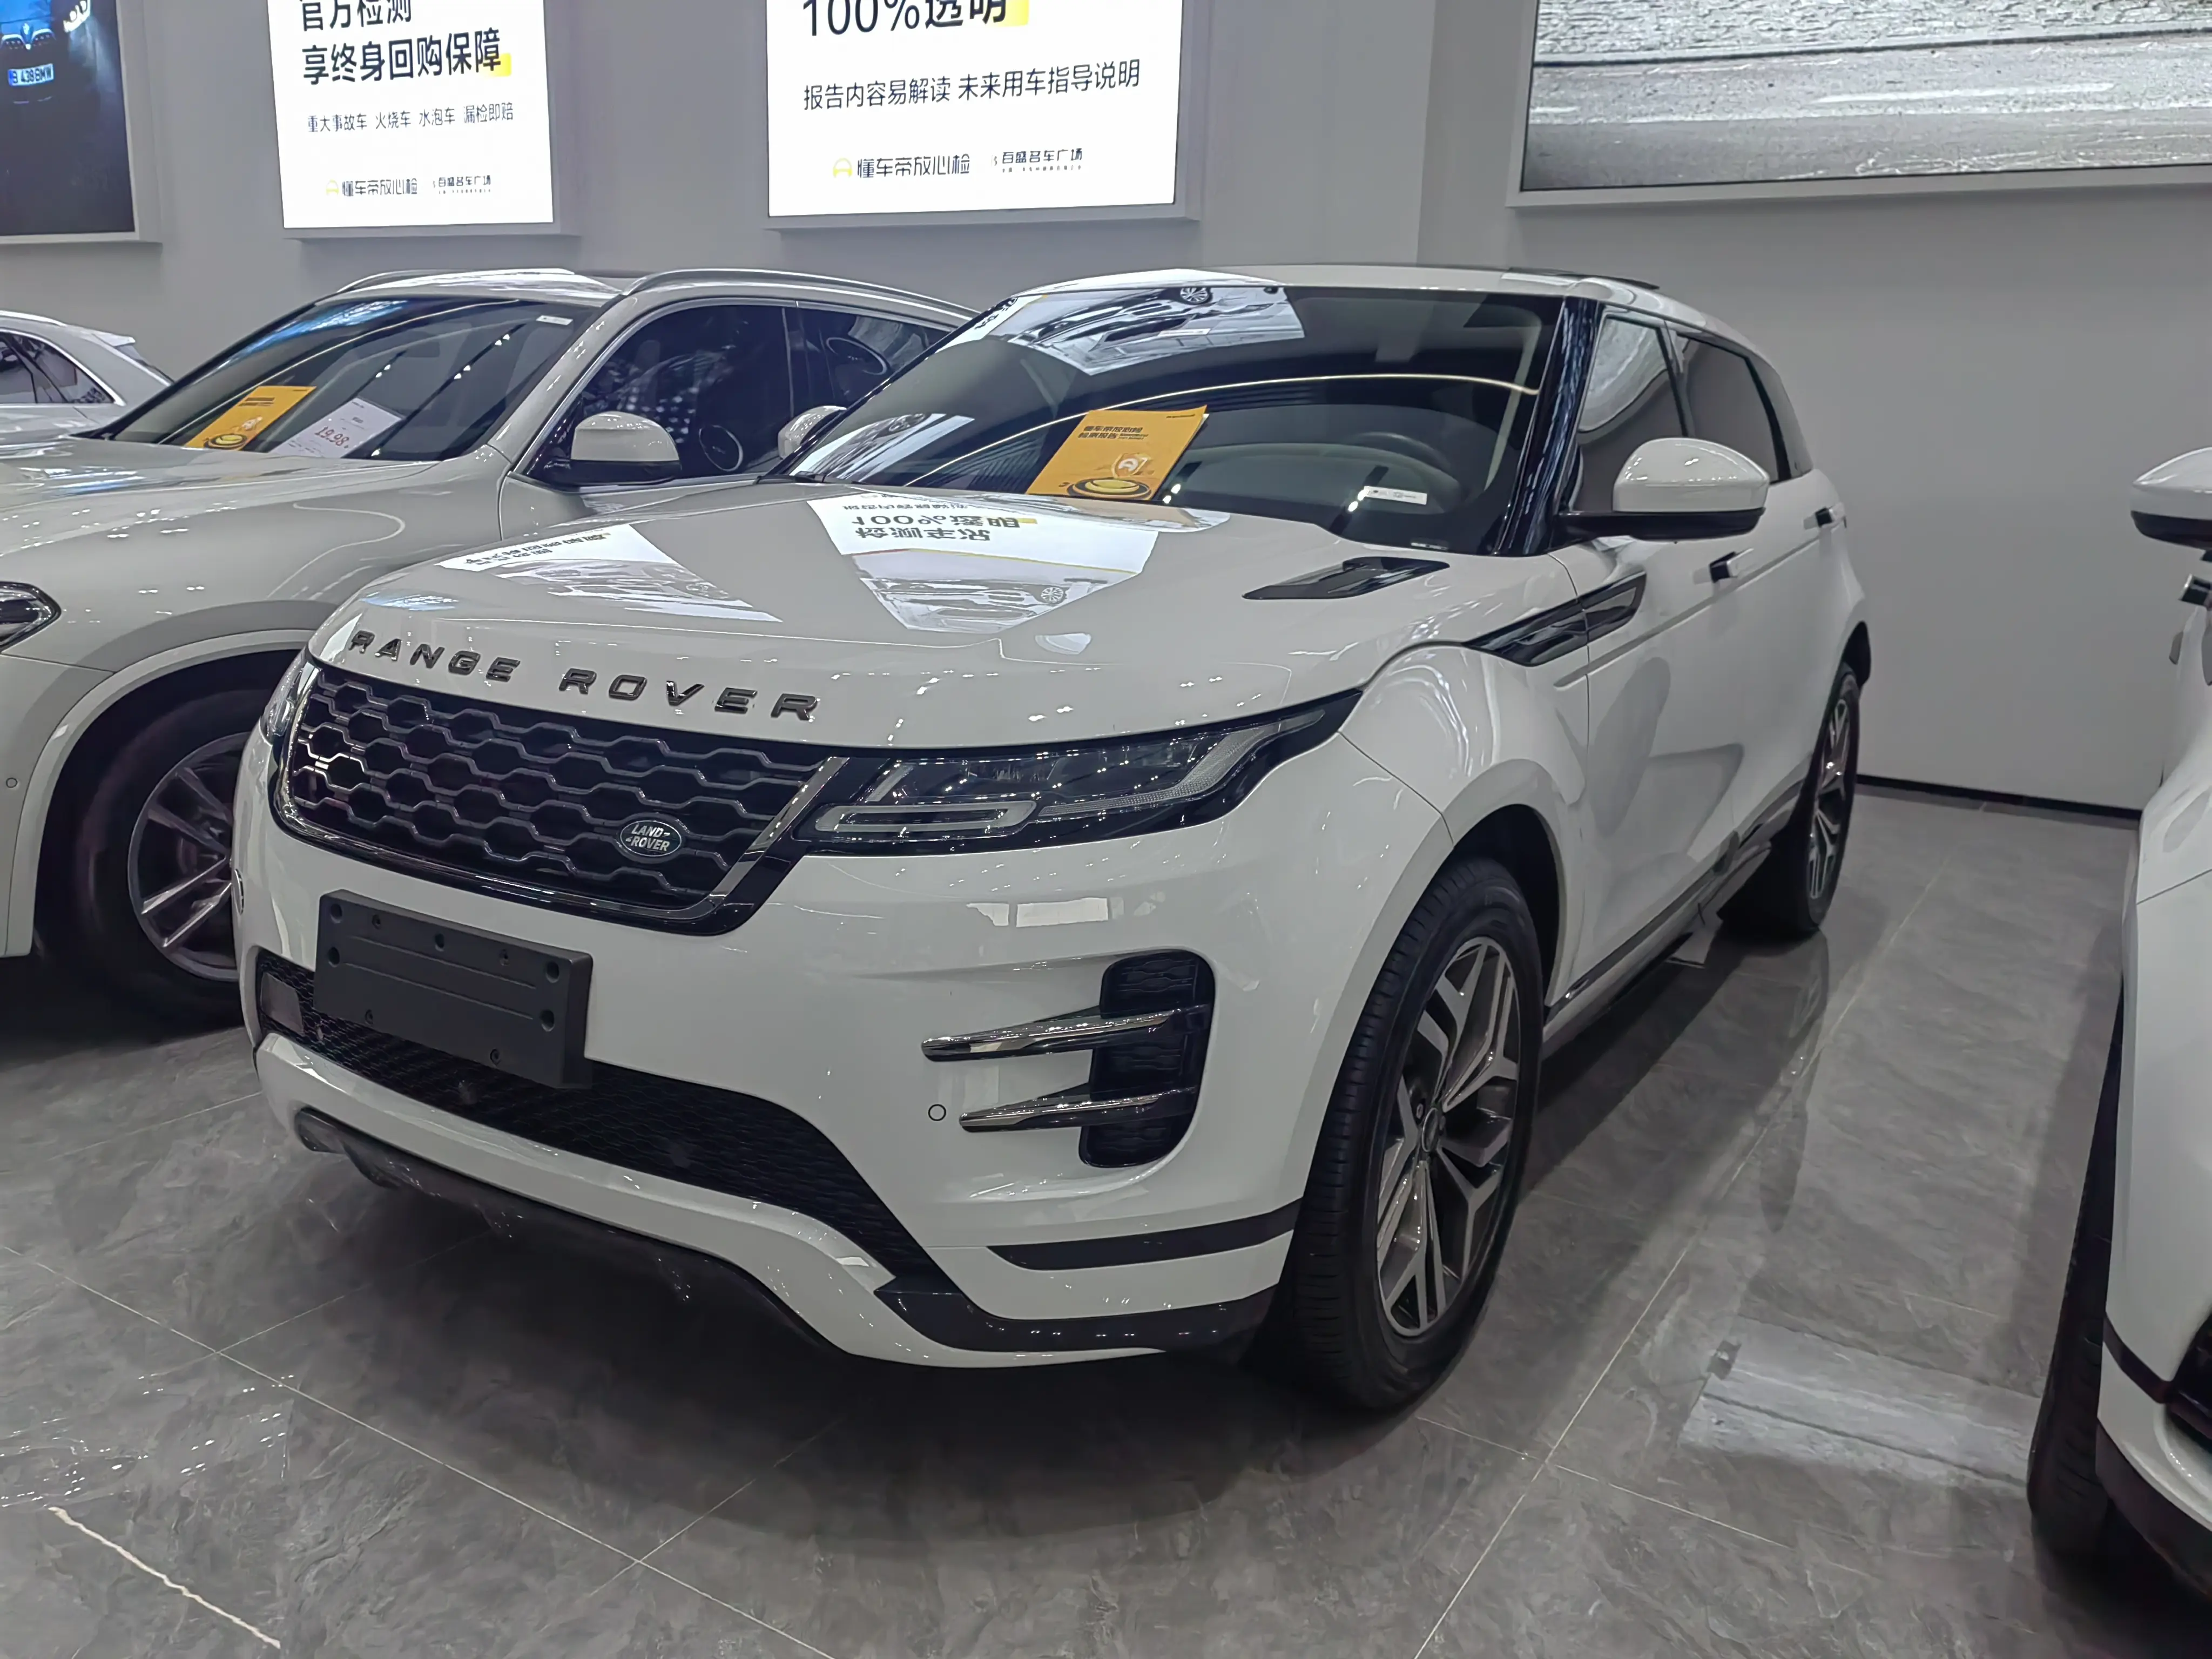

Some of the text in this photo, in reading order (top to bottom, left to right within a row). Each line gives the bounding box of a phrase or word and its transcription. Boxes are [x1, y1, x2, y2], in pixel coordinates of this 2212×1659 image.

[300, 0, 412, 32] 官方检测
[302, 27, 502, 85] 享终身回购保障
[804, 59, 1140, 110] 报告内容易解读 未来用车指导说明
[308, 102, 514, 133] 重大事故车 火烧车 水泡车 漏检即赔
[857, 153, 970, 178] 懂车帝放心检
[1002, 147, 1083, 164] 百盛名车广场
[348, 630, 821, 721] RANGE ROVER
[631, 822, 664, 838] LAND
[631, 837, 670, 852] ROVER
